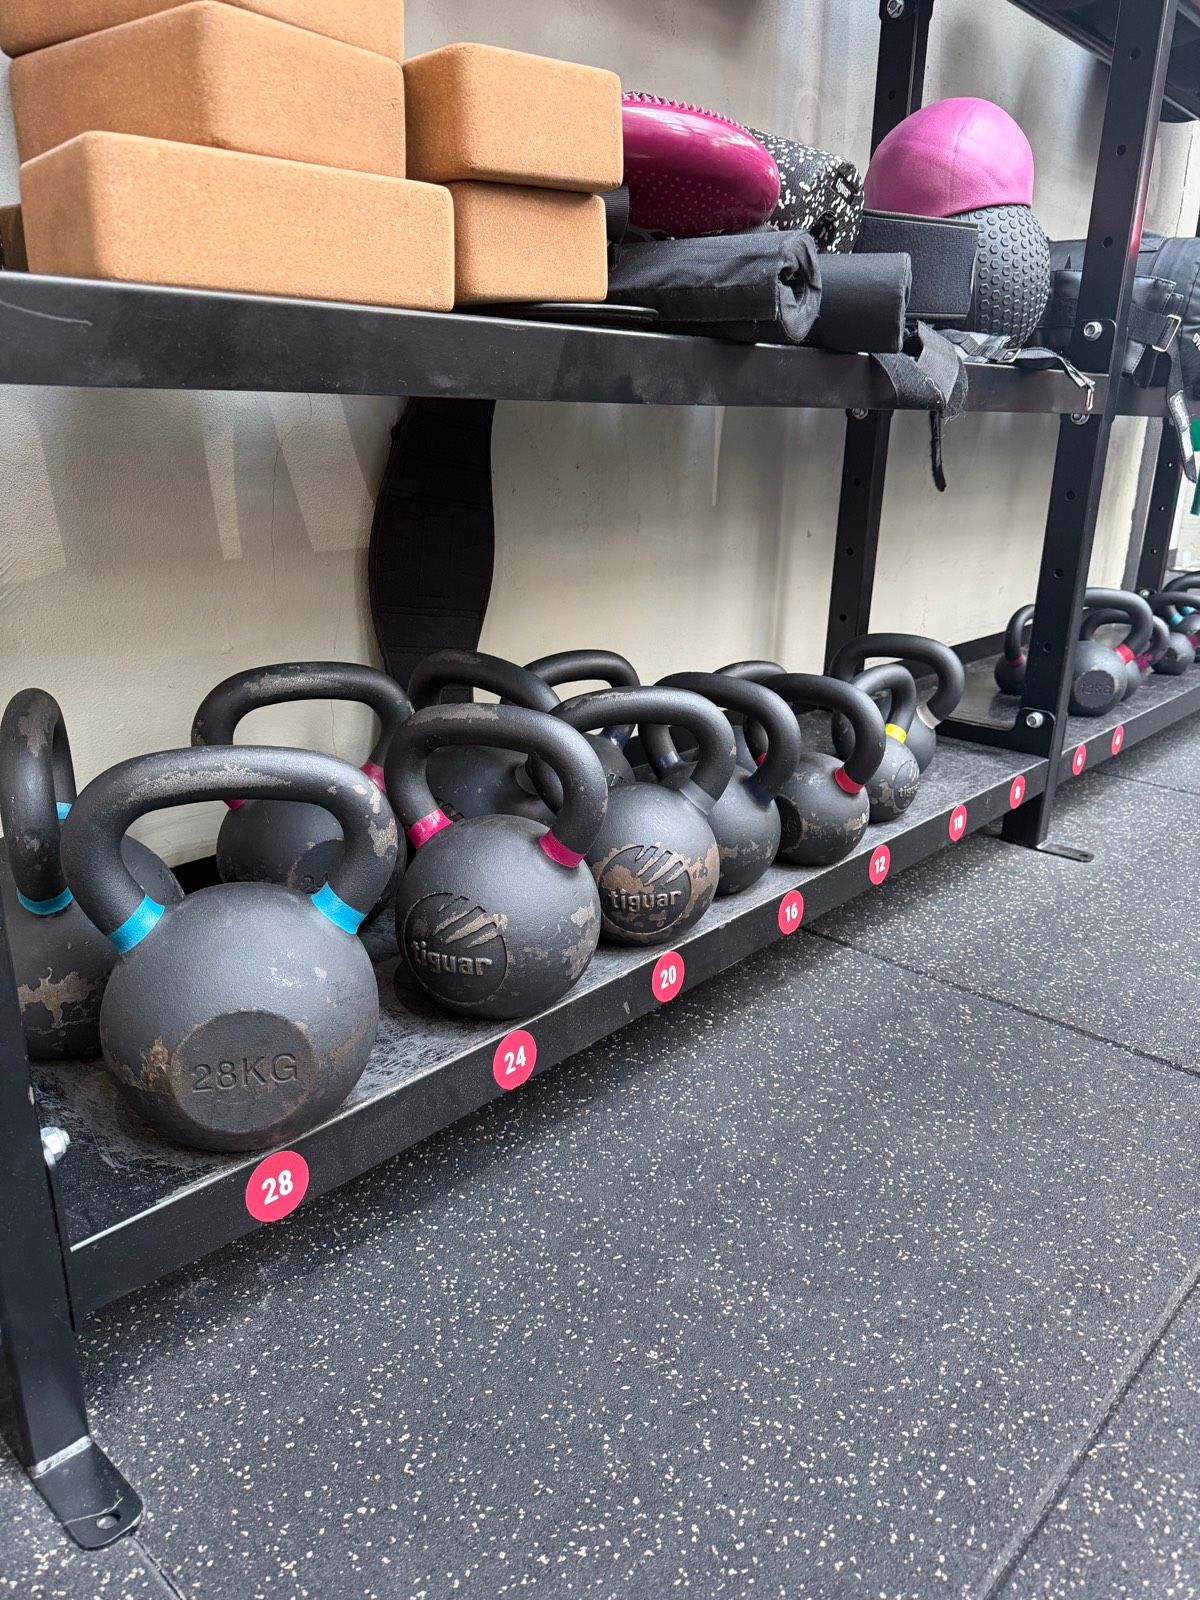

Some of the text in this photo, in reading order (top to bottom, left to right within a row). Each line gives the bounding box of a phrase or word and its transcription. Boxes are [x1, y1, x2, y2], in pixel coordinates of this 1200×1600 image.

[1014, 785, 1021, 800] 8
[953, 814, 964, 831] 10
[874, 855, 886, 874] 12
[608, 888, 682, 913] tiguar
[784, 902, 798, 922] 16
[410, 940, 493, 976] tiguar
[660, 965, 677, 989] 20
[504, 1045, 527, 1075] 24
[191, 1052, 299, 1094] 28KG
[261, 1169, 294, 1206] 28
